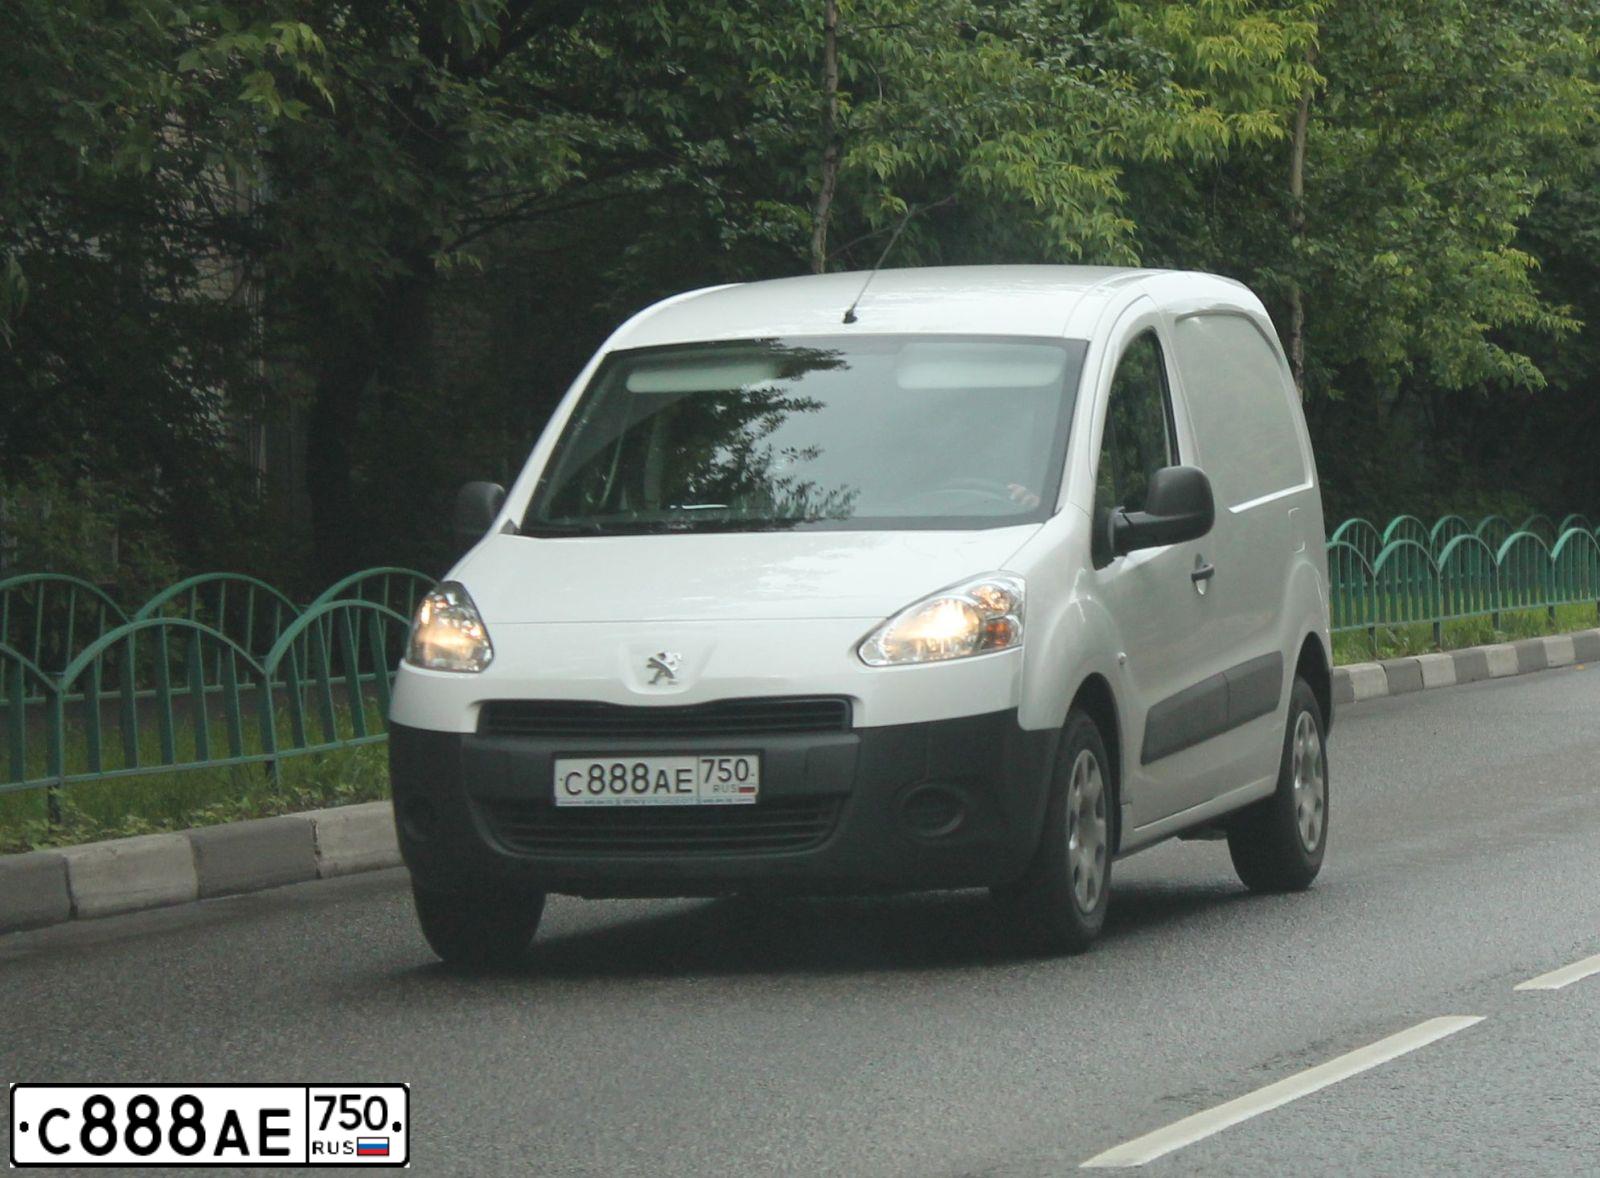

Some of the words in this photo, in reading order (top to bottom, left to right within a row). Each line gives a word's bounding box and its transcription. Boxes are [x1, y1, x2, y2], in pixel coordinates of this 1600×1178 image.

[565, 762, 692, 795] C888AE
[701, 758, 749, 783] 750
[713, 784, 738, 793] RUS
